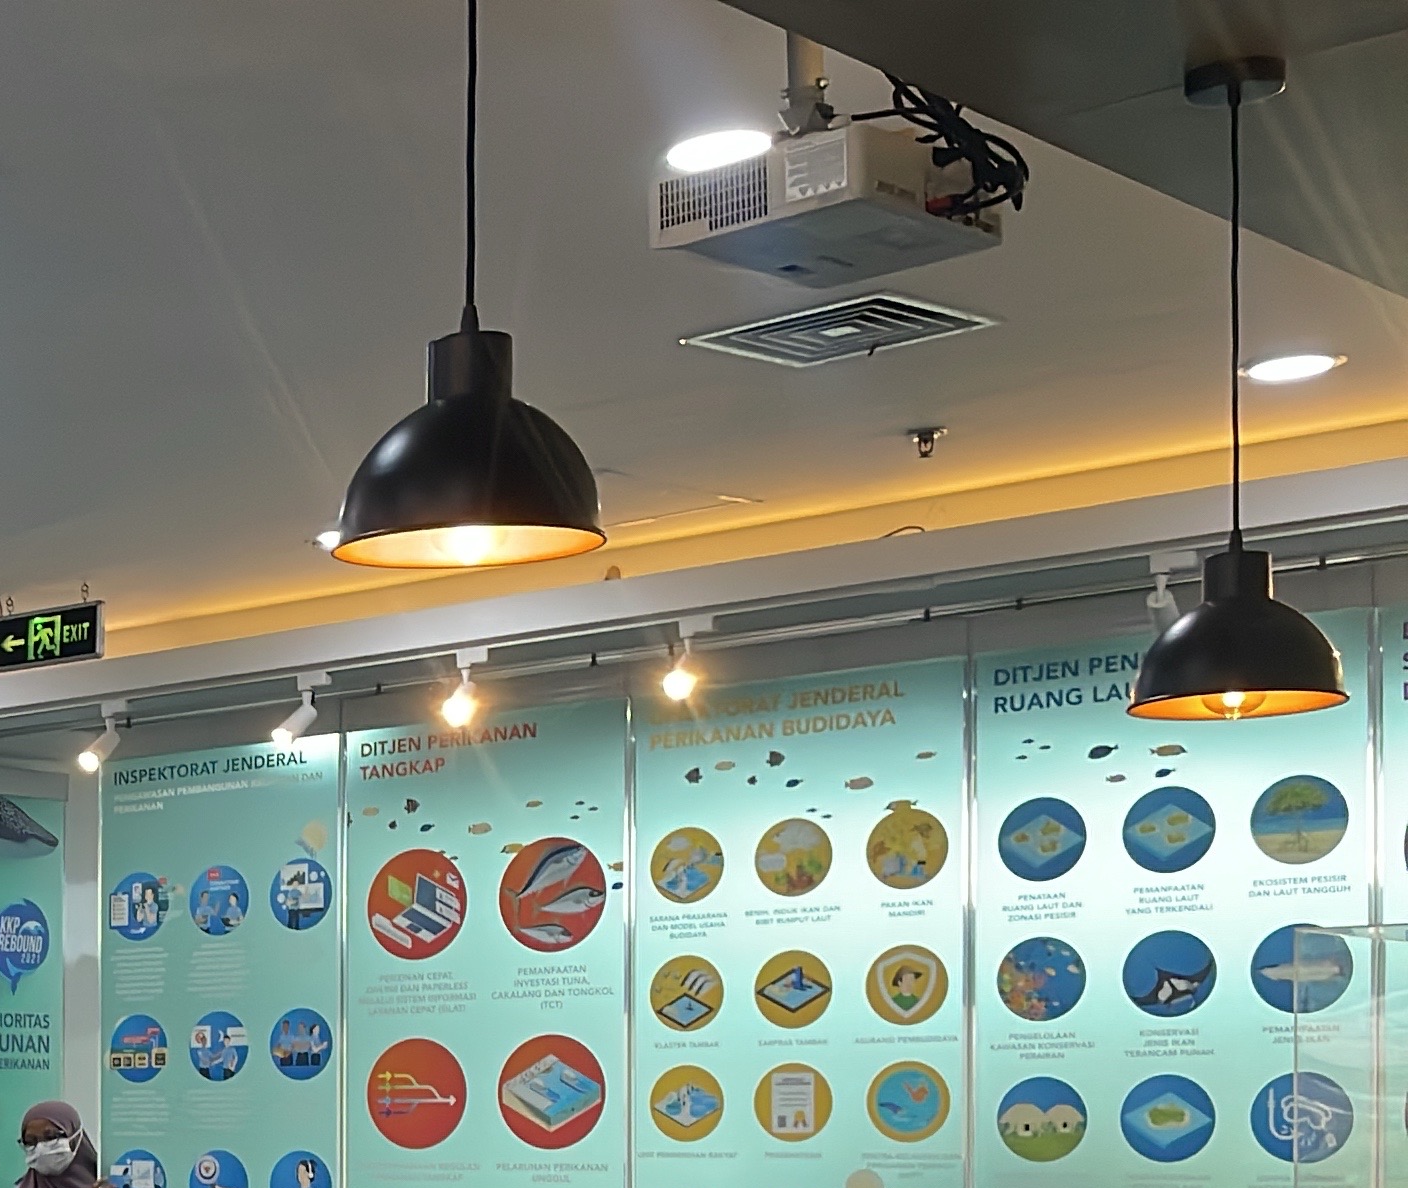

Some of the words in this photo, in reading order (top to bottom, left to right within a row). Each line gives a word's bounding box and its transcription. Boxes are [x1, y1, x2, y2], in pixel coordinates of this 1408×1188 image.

[63, 621, 90, 643] EXIT
[993, 659, 1080, 686] DITJEN
[1088, 652, 1139, 675] PEN
[788, 680, 905, 709] JENDERAL
[994, 688, 1083, 714] RUANG
[649, 722, 774, 750] PERIKANAN
[782, 708, 897, 737] BUDIDAYA
[360, 737, 421, 758] DITJEN
[428, 722, 537, 749] PERIKANAN
[113, 760, 219, 786] INSPEKTORAT
[222, 750, 307, 773] JENDERAL
[360, 757, 445, 781] TANGKAP
[177, 780, 248, 796] PEMBANGUNAN
[1253, 877, 1308, 887] EKOSISTEM
[1311, 875, 1347, 883] PESISIR
[1133, 884, 1204, 893] PEMANFAATAN
[1248, 890, 1270, 898] DAN
[1273, 888, 1298, 896] LAUT
[1301, 885, 1351, 894] TANGGUH
[1018, 892, 1066, 901] PENATAAN
[1139, 896, 1172, 904] RUANG
[1175, 894, 1199, 902] LAUT
[1002, 904, 1034, 912] RUANG
[1037, 902, 1059, 910] LAUT
[1062, 901, 1082, 909] DAN
[1125, 906, 1151, 915] YANG
[1155, 903, 1214, 913] TERKENDALI
[649, 915, 680, 923] SARANA
[811, 914, 831, 922] LAUT
[1007, 914, 1042, 922] ZONASI
[0, 915, 20, 934] KKP
[21, 953, 42, 965] 2021
[518, 965, 586, 976] PEMANFAATAN
[400, 984, 420, 992] DAN
[422, 981, 469, 991] PAPERLESS
[514, 977, 559, 987] INVESTASI
[562, 976, 590, 986] TUNA,
[491, 990, 542, 1000] CAKALANG
[544, 989, 565, 998] DAN
[568, 986, 614, 996] TONGKOL
[410, 1005, 436, 1014] CEPAT
[540, 1000, 564, 1010] (TCT)
